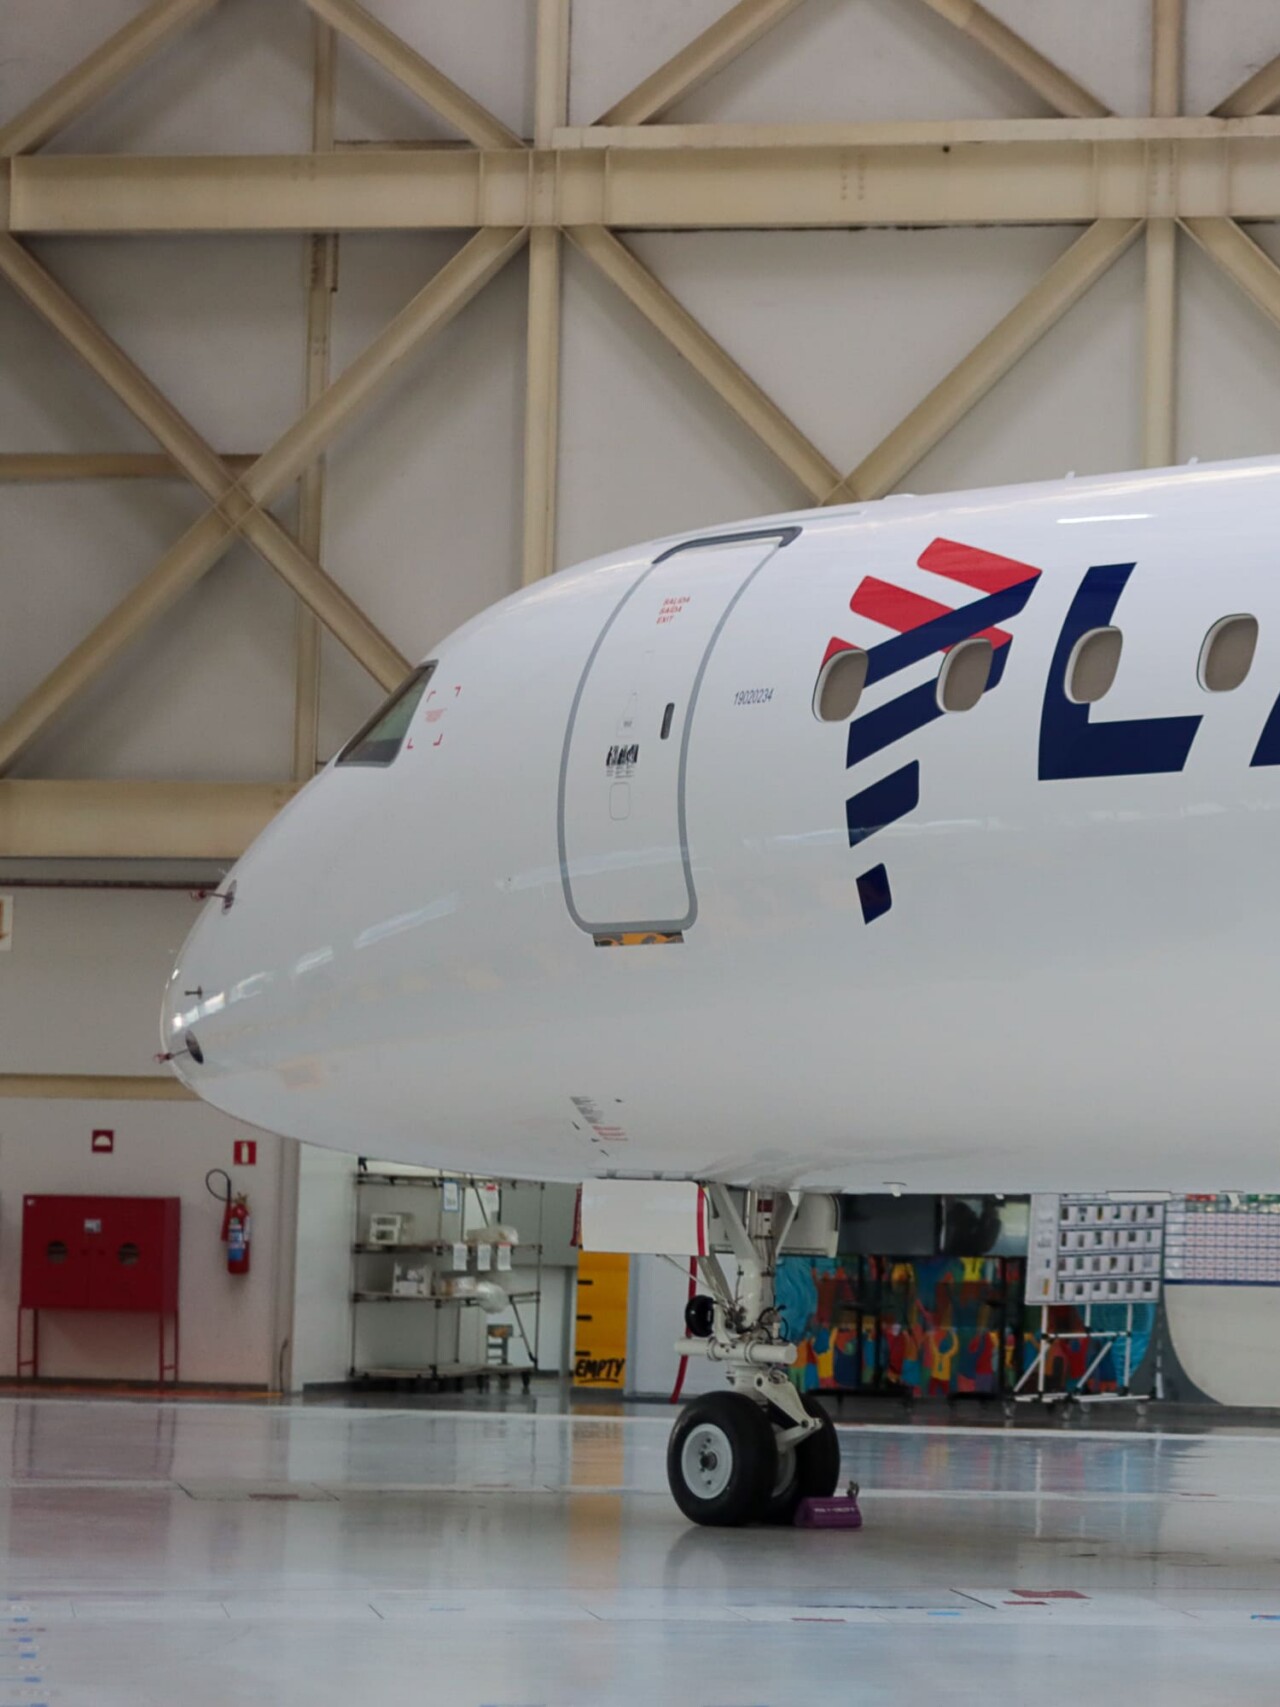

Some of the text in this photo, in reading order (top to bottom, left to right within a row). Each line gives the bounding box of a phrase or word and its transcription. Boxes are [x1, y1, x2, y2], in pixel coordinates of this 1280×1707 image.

[656, 615, 674, 625] EXIT
[733, 687, 775, 706] 19020234
[574, 1357, 626, 1378] EMPTY
